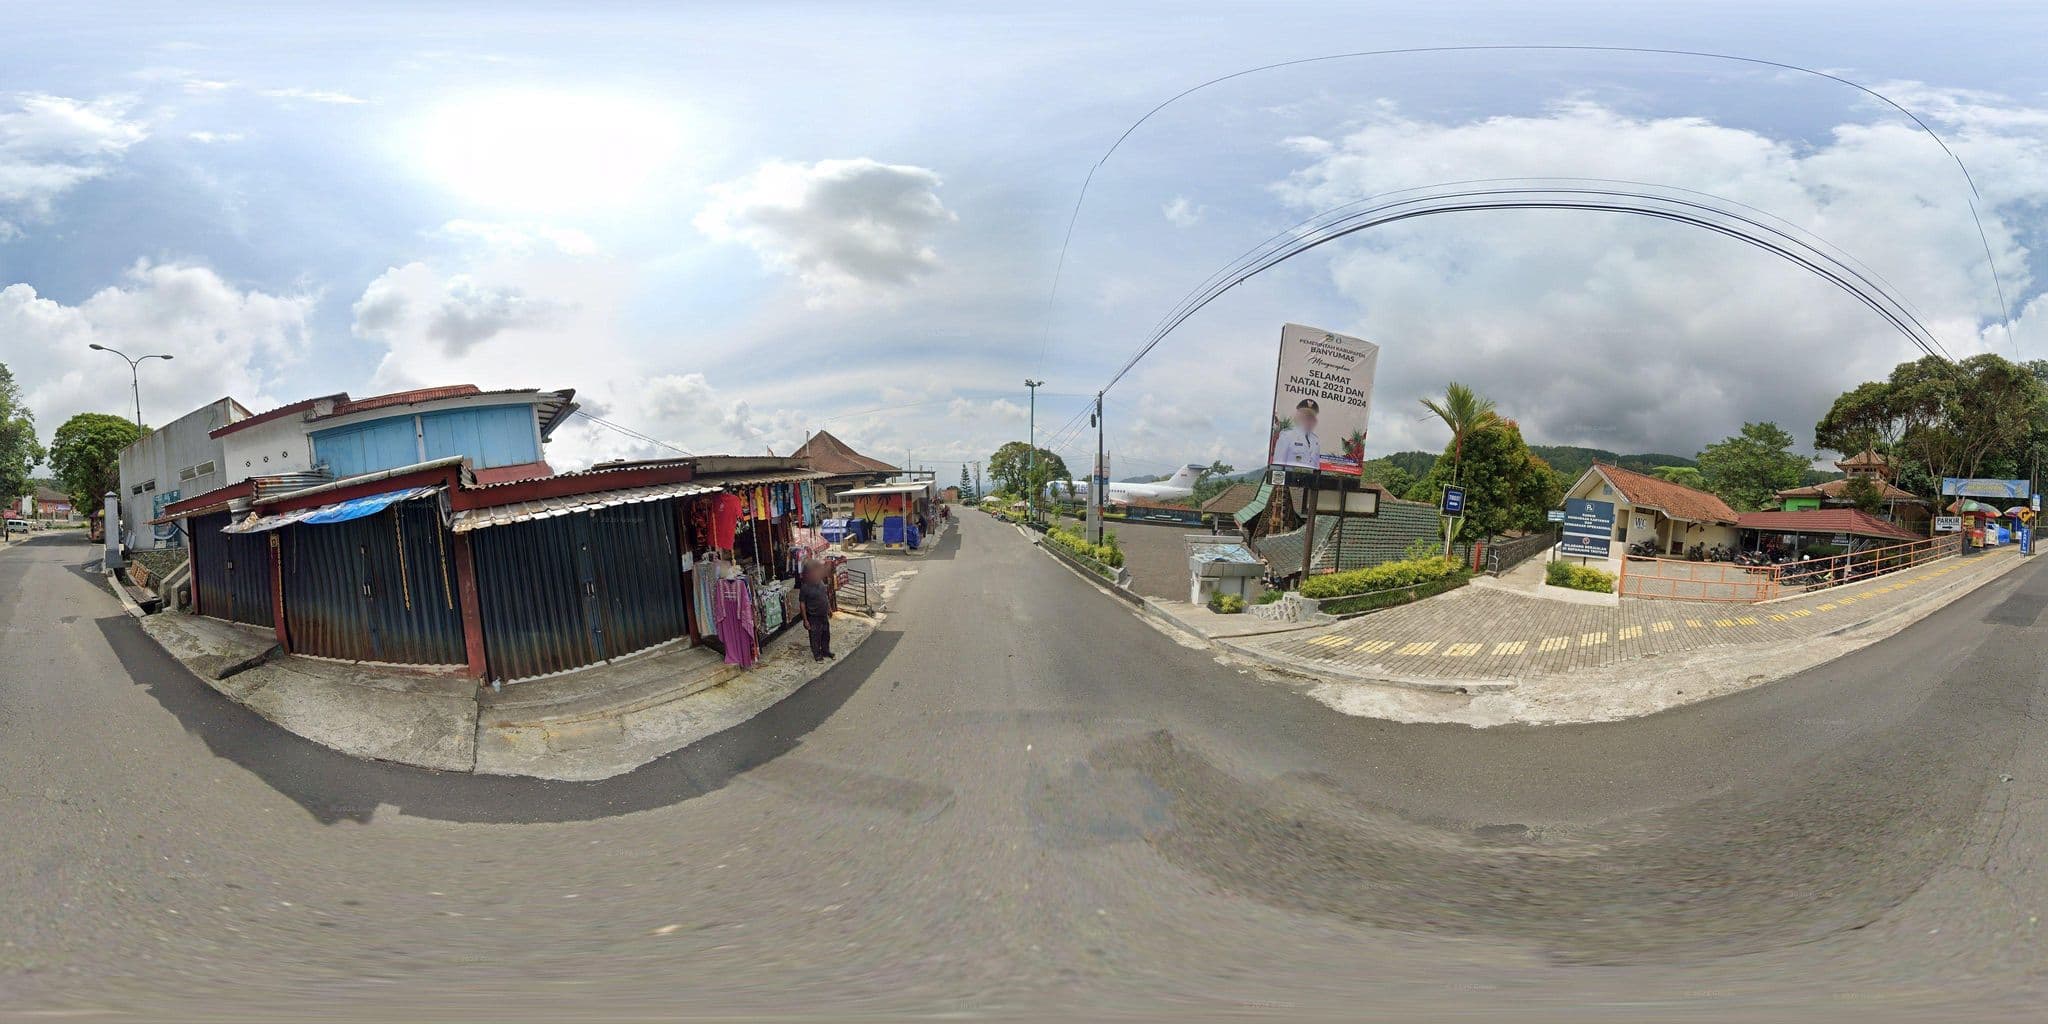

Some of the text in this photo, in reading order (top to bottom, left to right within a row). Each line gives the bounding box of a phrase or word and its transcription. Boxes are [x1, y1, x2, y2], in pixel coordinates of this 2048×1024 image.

[1299, 339, 1366, 358] PEMERINTAH KABUPATEN
[1310, 346, 1355, 362] BANYUMAS
[1290, 375, 1364, 398] NATAL 2023 DAN
[1308, 369, 1352, 385] SELAMAT
[1284, 384, 1367, 408] TAHUN BARU 2024
